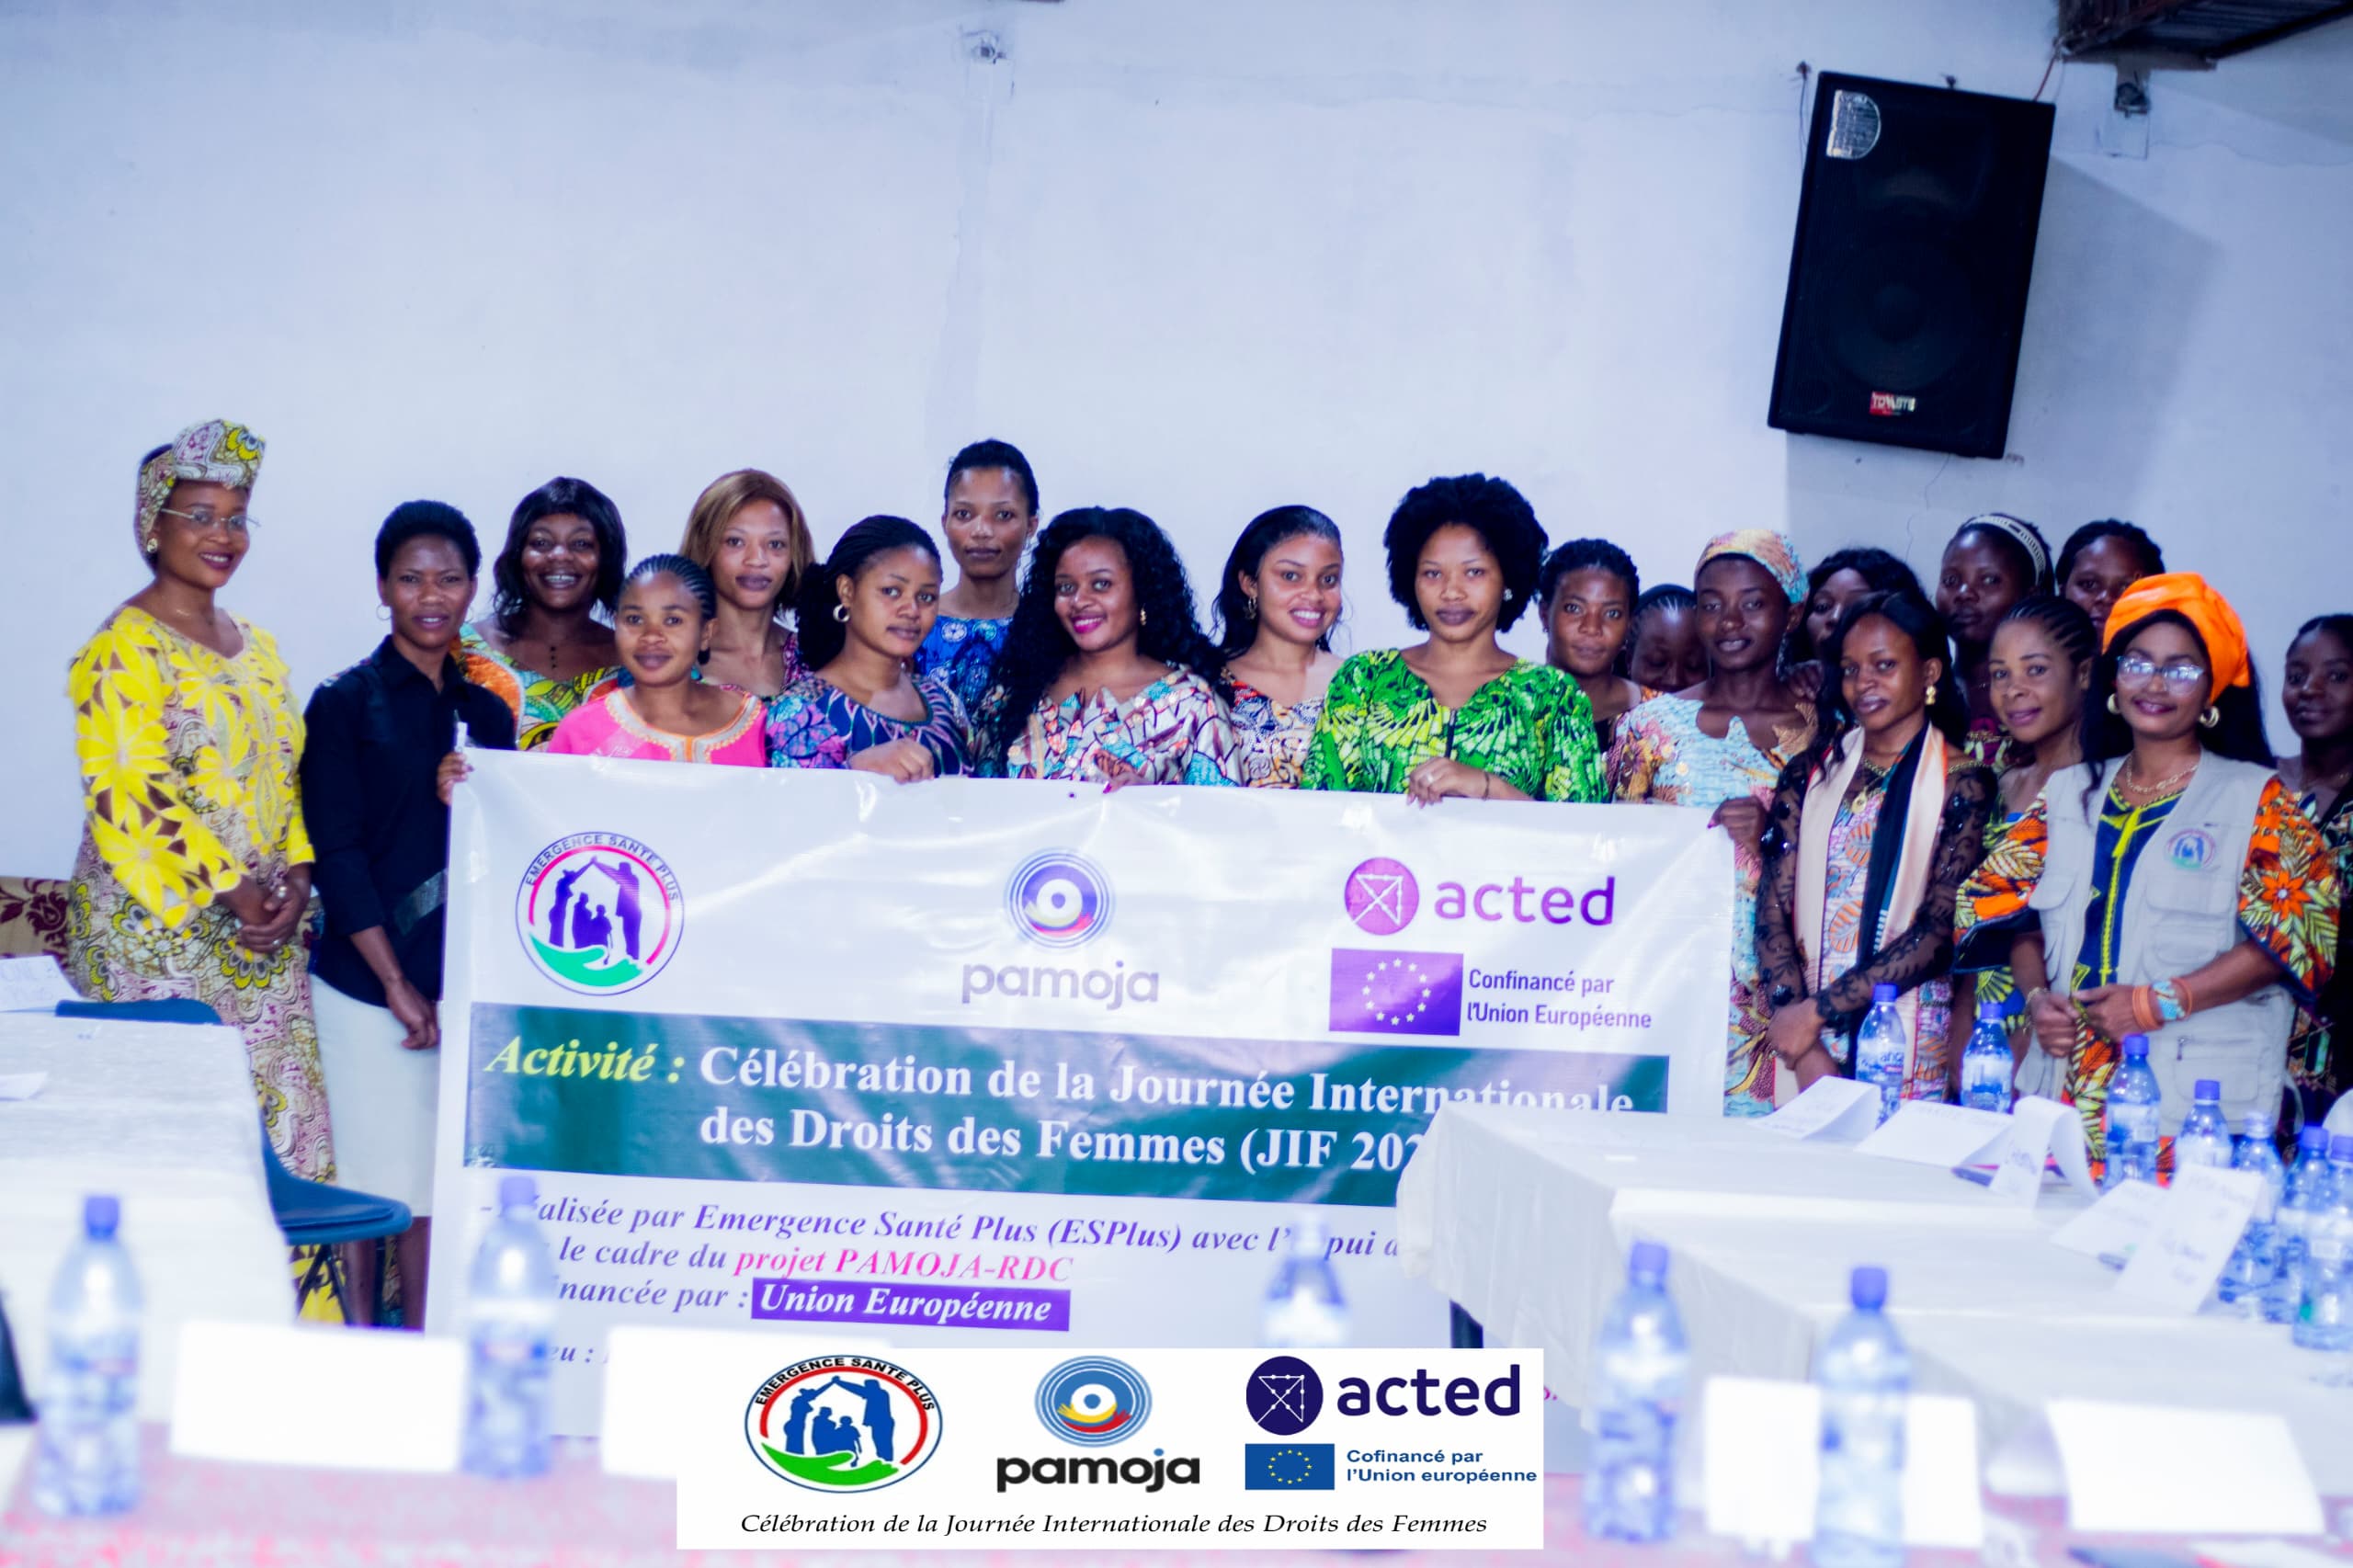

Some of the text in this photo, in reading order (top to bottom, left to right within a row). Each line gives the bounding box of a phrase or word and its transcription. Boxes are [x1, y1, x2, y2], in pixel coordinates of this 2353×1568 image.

[526, 835, 603, 886] EMERGENCE
[655, 864, 679, 902] PLUS
[1435, 876, 1616, 926] acted
[962, 960, 1159, 1011] pamoja
[1469, 968, 1615, 996] Confinancé par
[1536, 1002, 1653, 1030] Européenne
[483, 1036, 658, 1083] Activité
[699, 1046, 972, 1096] Célébration
[988, 1060, 1040, 1098] de
[1056, 1061, 1096, 1101] la
[1109, 1063, 1295, 1109] Journée
[700, 1108, 774, 1145] des
[790, 1108, 932, 1152] Droits
[947, 1117, 1021, 1156] des
[1036, 1120, 1226, 1166] Femmes
[1240, 1127, 1338, 1175] (JIF
[499, 1197, 623, 1225] alisée
[628, 1208, 684, 1233] par
[694, 1204, 865, 1240] Emergence
[874, 1210, 963, 1240] Santé
[971, 1215, 1037, 1244] Plus
[1049, 1219, 1182, 1253] (ESPlus)
[1192, 1231, 1258, 1251] avec
[559, 1237, 1074, 1281] le cadre du projet PAMOJA-RDC
[672, 1288, 728, 1312] par
[760, 1284, 855, 1314] Union
[863, 1287, 1051, 1324] Européenne
